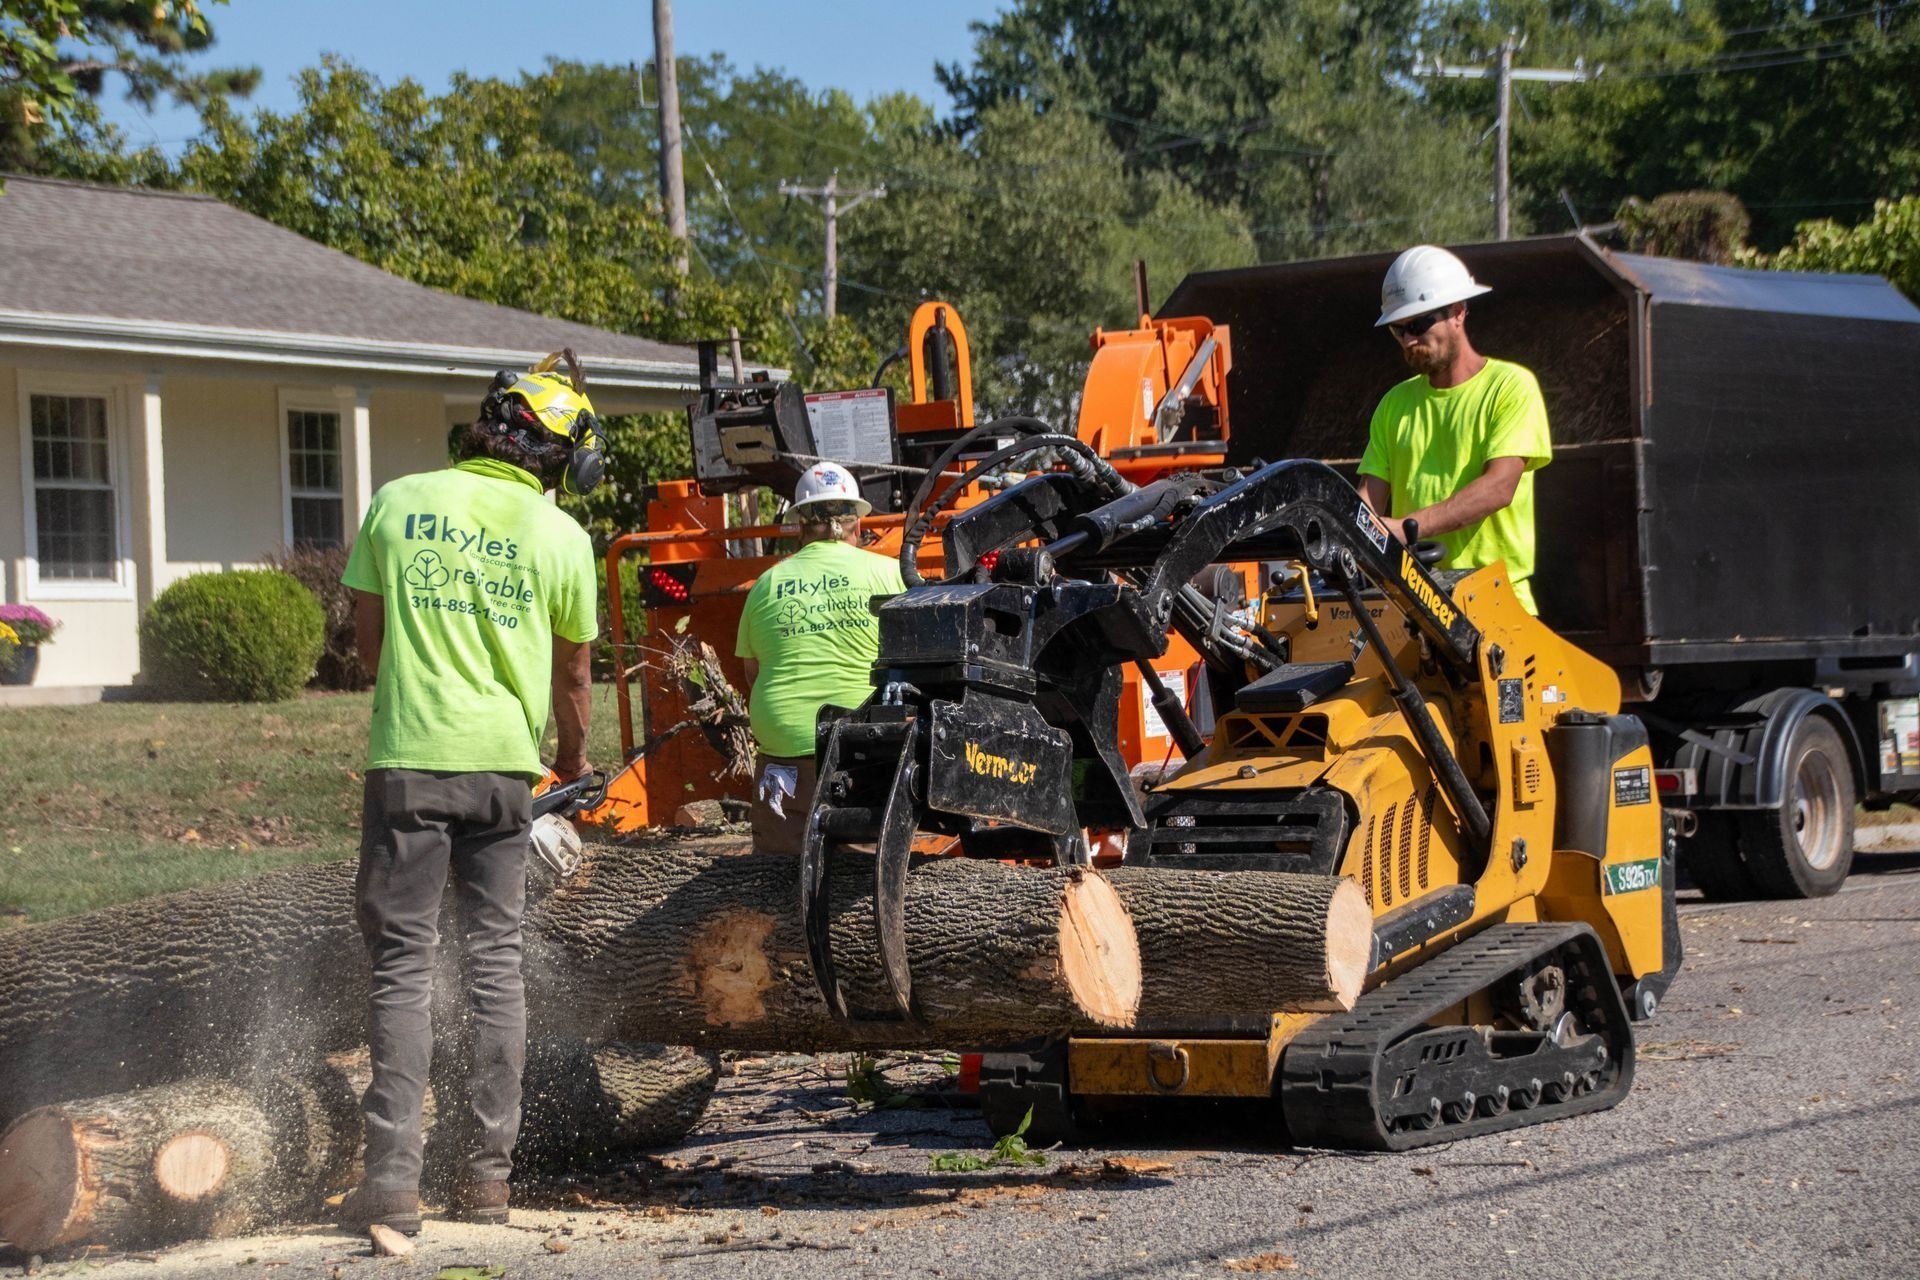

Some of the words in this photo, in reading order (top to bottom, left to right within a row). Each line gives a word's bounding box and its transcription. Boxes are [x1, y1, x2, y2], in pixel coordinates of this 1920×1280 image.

[442, 516, 518, 560] kyle's
[454, 568, 534, 603] reliable
[799, 574, 850, 596] kyle's
[1400, 549, 1457, 630] Vermeer
[412, 596, 518, 629] 314-892-1500
[511, 603, 531, 613] care
[1330, 607, 1384, 620] Verer
[783, 619, 870, 638] 314-892-1500
